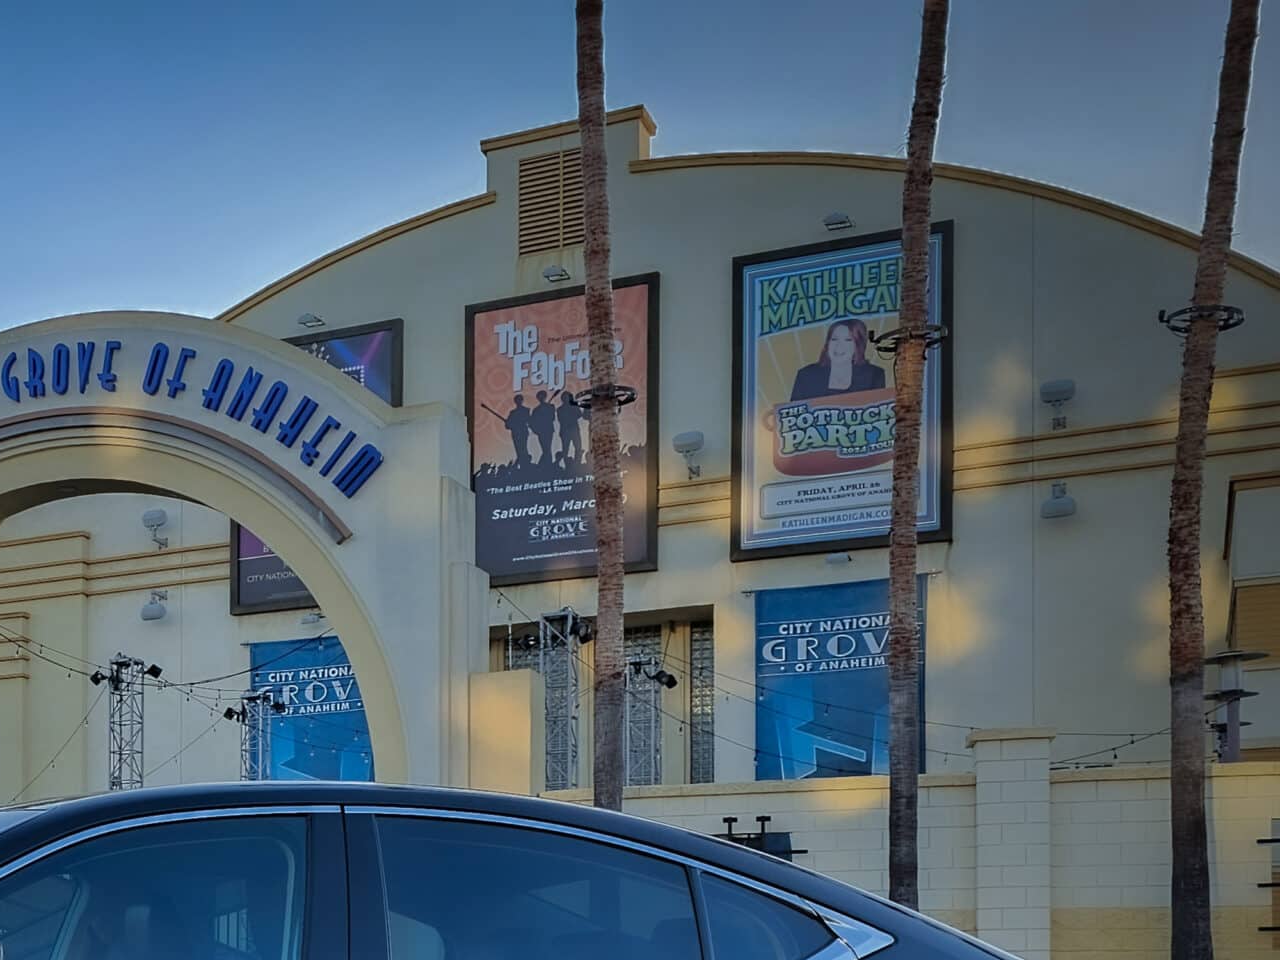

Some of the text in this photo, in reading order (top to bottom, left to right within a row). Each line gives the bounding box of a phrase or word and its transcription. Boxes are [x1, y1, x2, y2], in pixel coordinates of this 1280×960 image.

[759, 257, 904, 306] KATHLEE
[759, 283, 902, 336] MADIGA
[493, 320, 539, 358] The
[0, 339, 123, 404] GROVE
[142, 342, 197, 399] OF
[202, 357, 385, 499] ANAHEIM
[780, 404, 807, 417] THE
[781, 401, 896, 433] POTLUCK
[782, 419, 896, 454] PARTY
[869, 440, 895, 451] TOU
[838, 482, 868, 492] APRIL
[492, 499, 596, 521] Saturday, Marc
[781, 509, 890, 529] KATHLEENMADIGAN.CO
[529, 521, 588, 538] GROVE
[779, 614, 891, 635] CITY NATION
[762, 630, 890, 663] GROV
[268, 666, 356, 683] CITY NATIONA
[795, 656, 886, 672] OF ANAHEIM
[256, 679, 355, 706] GROV
[298, 702, 350, 714] ANAHEIM
